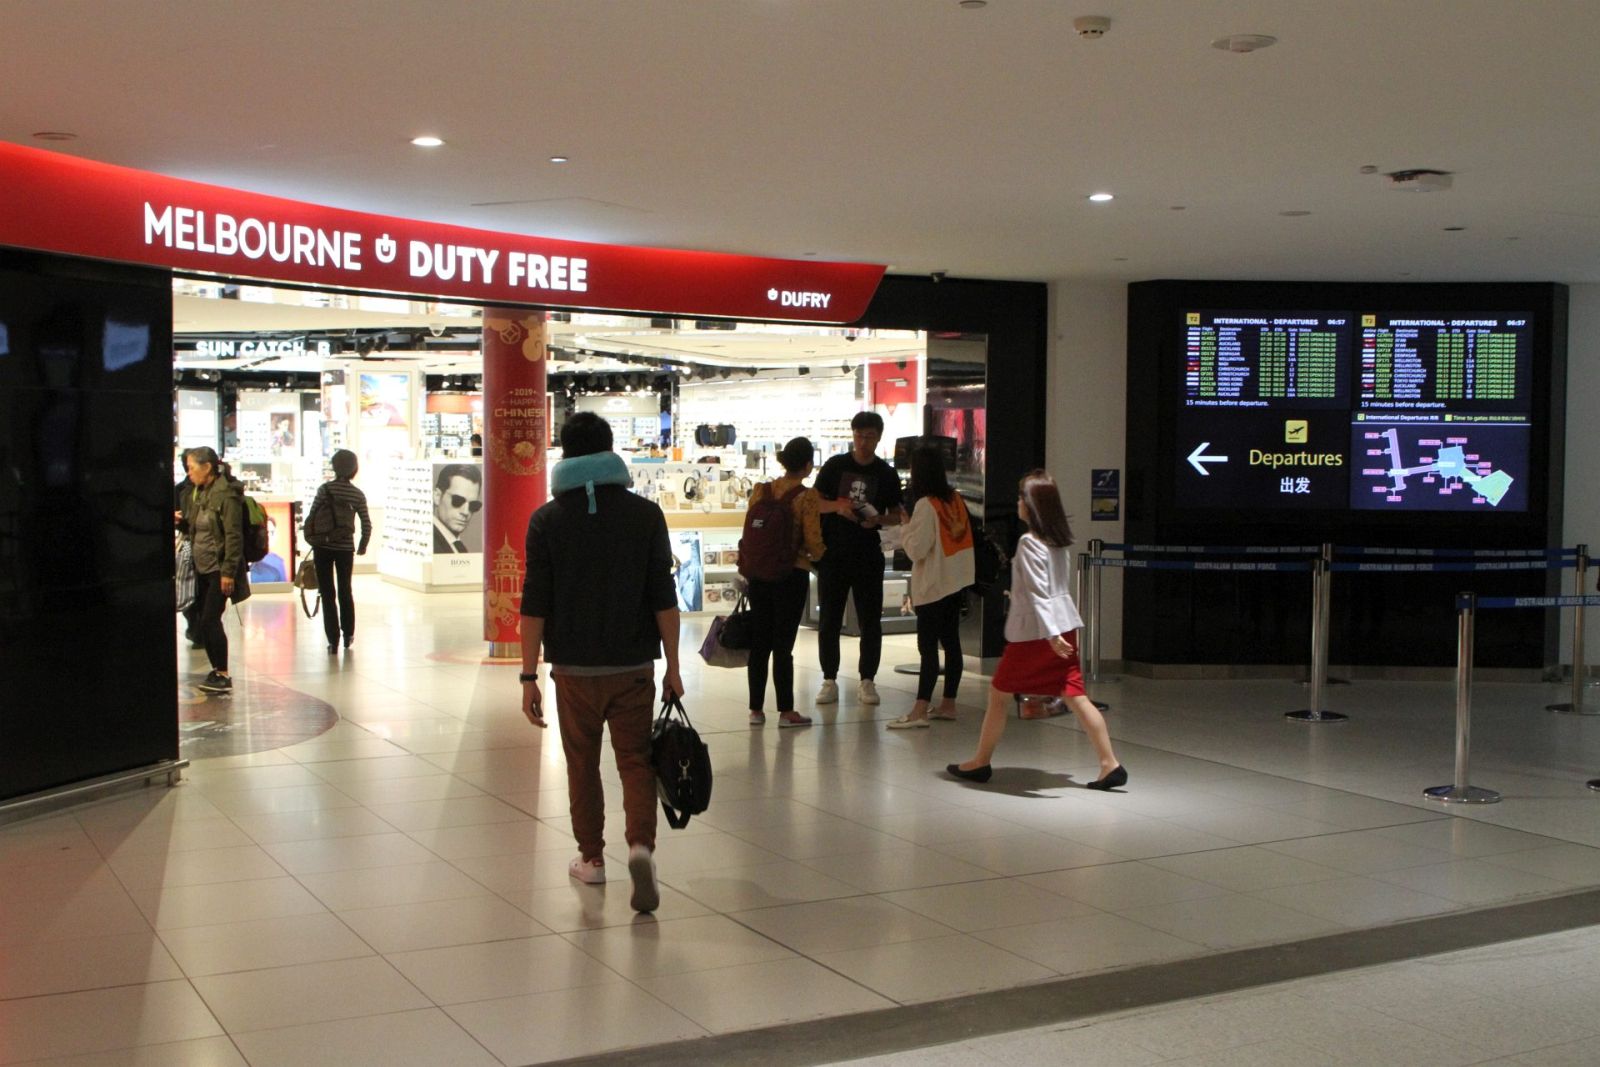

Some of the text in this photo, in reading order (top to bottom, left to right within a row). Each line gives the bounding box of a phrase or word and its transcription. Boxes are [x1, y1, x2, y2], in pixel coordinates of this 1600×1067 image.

[144, 202, 587, 292] MELBOURNE DUTY FREE
[782, 290, 831, 308] DUFRY
[196, 340, 331, 358] SUN CATCHR
[1250, 450, 1342, 469] Departures
[1280, 476, 1310, 493] 出发
[1515, 597, 1556, 607] AUSTRALIAN
